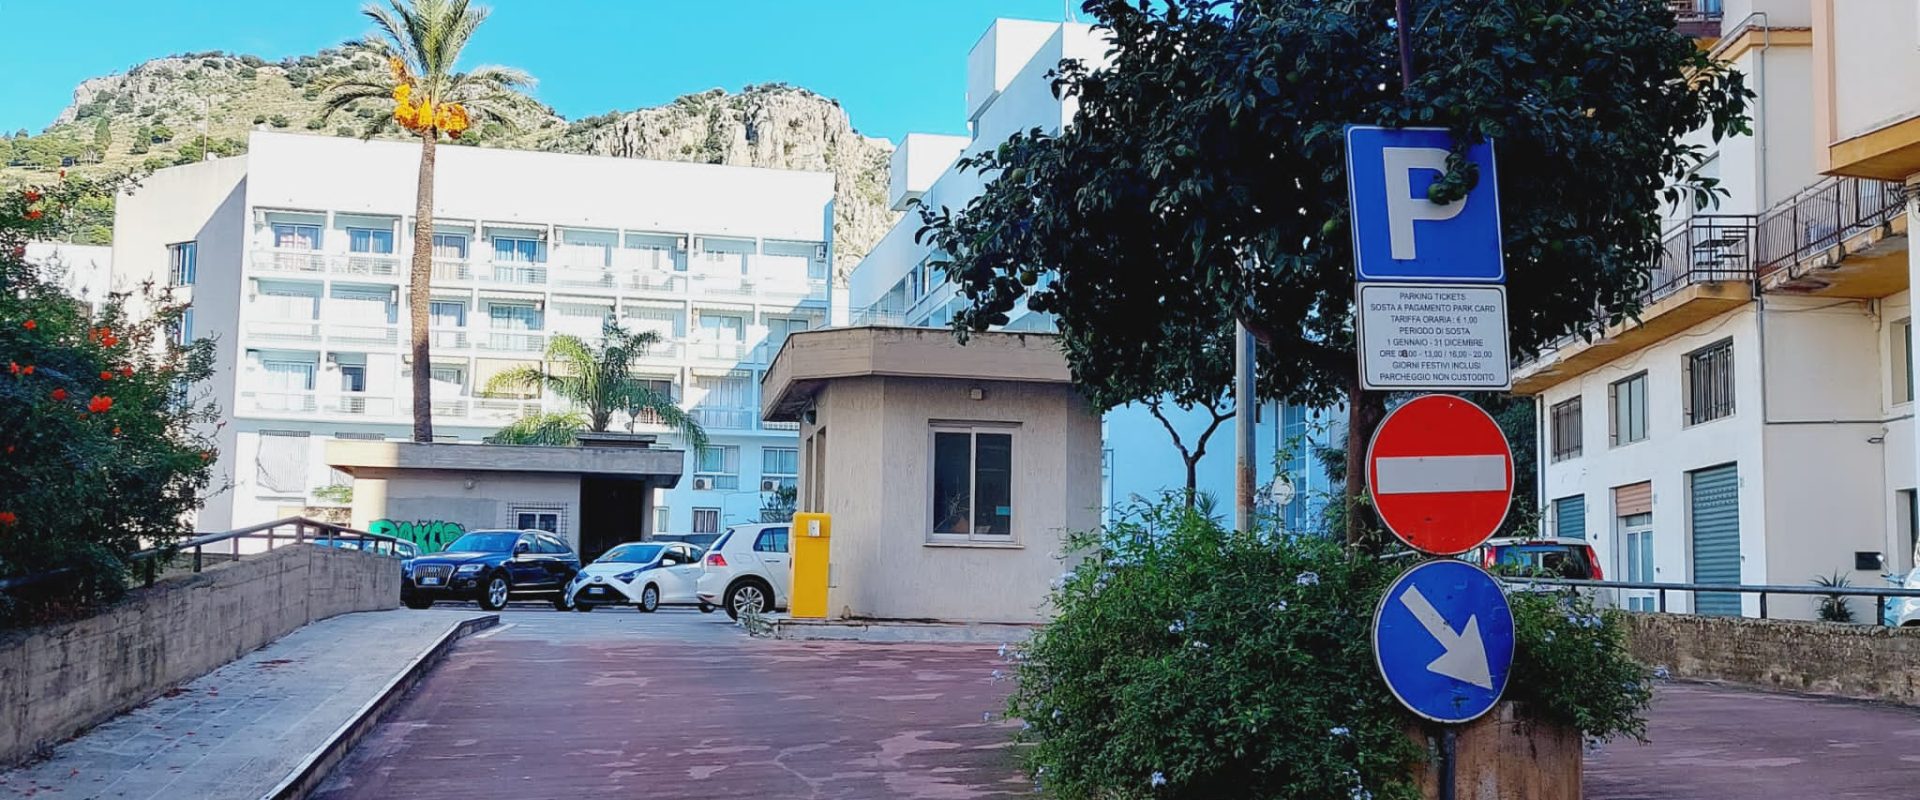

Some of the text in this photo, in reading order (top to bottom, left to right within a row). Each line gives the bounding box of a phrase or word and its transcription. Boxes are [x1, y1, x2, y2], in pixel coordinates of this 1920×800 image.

[1383, 147, 1468, 260] P
[1399, 292, 1466, 301] PARKING TICKETS
[1370, 303, 1396, 311] SOSTA
[1404, 304, 1452, 312] PAGAMENTO
[1452, 304, 1473, 312] PARK
[1390, 315, 1421, 323] TARIFFA
[1399, 326, 1471, 335] PERIODO DI SOSTA
[1392, 338, 1428, 346] GENNAIO
[1444, 338, 1483, 347] DICEMBRE
[1379, 349, 1396, 357] ORE
[1392, 361, 1481, 369] GIORNI FESTIVI INCLUSI
[1379, 372, 1495, 381] PARCHEGGIO NON CUSTODITO
